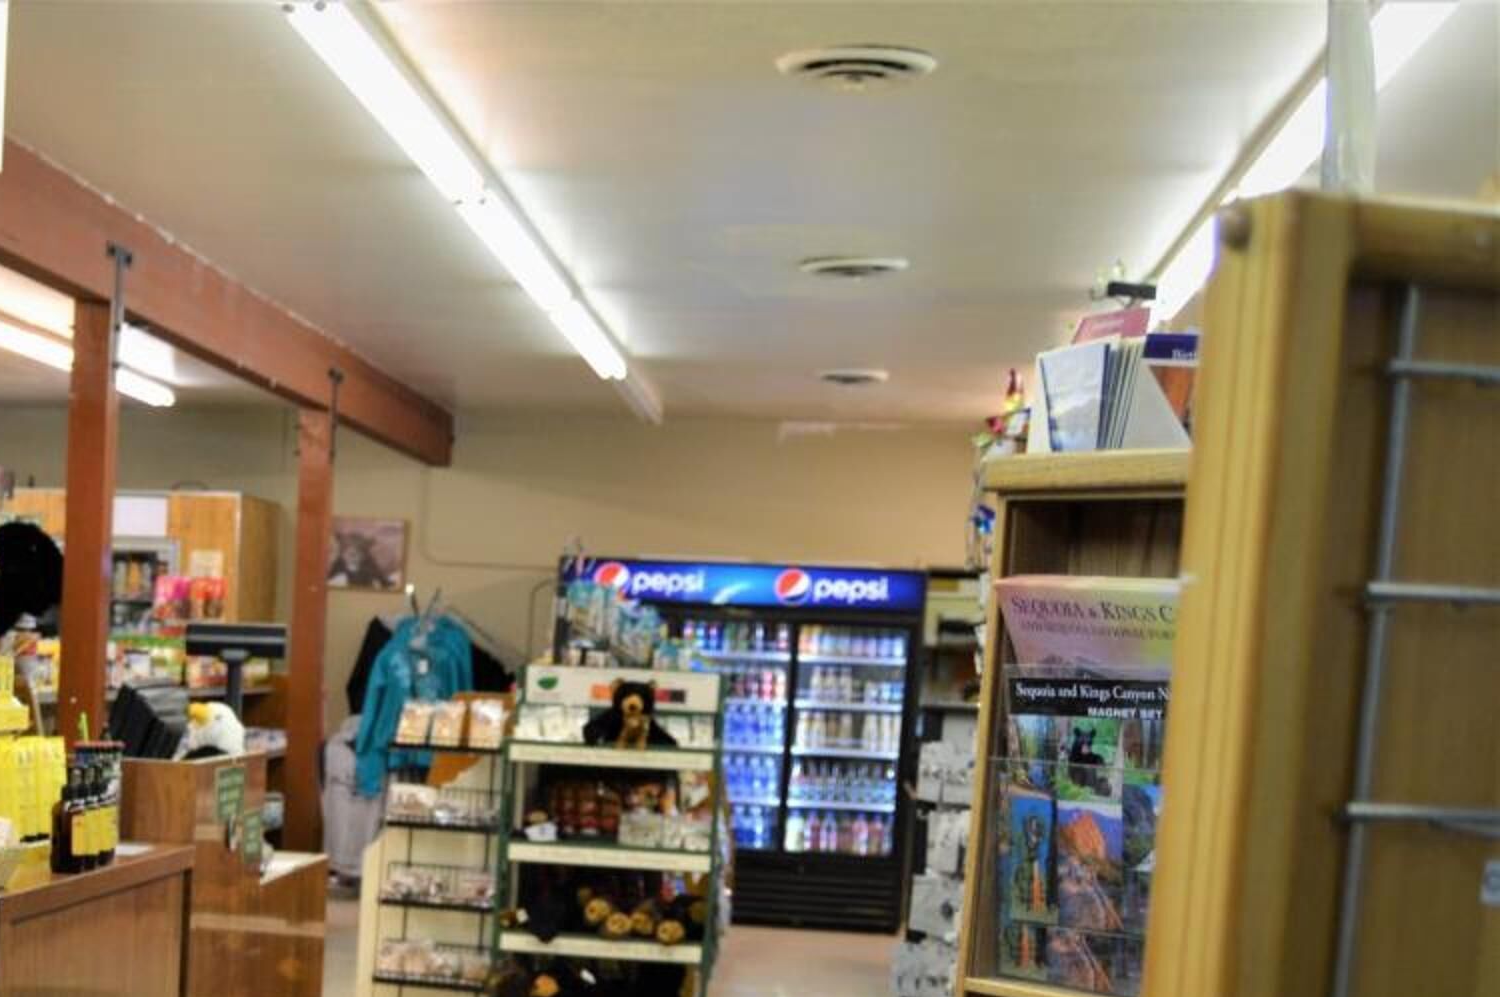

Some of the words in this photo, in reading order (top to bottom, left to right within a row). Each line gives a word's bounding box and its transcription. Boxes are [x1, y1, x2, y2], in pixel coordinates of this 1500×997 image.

[632, 570, 705, 597] pepsi
[813, 577, 889, 603] pepsi
[1015, 682, 1056, 700] Sequoia
[1058, 683, 1078, 698] and
[1080, 685, 1111, 702] Kings
[1113, 685, 1155, 703] Canyon
[1088, 707, 1136, 719] MAGNET
